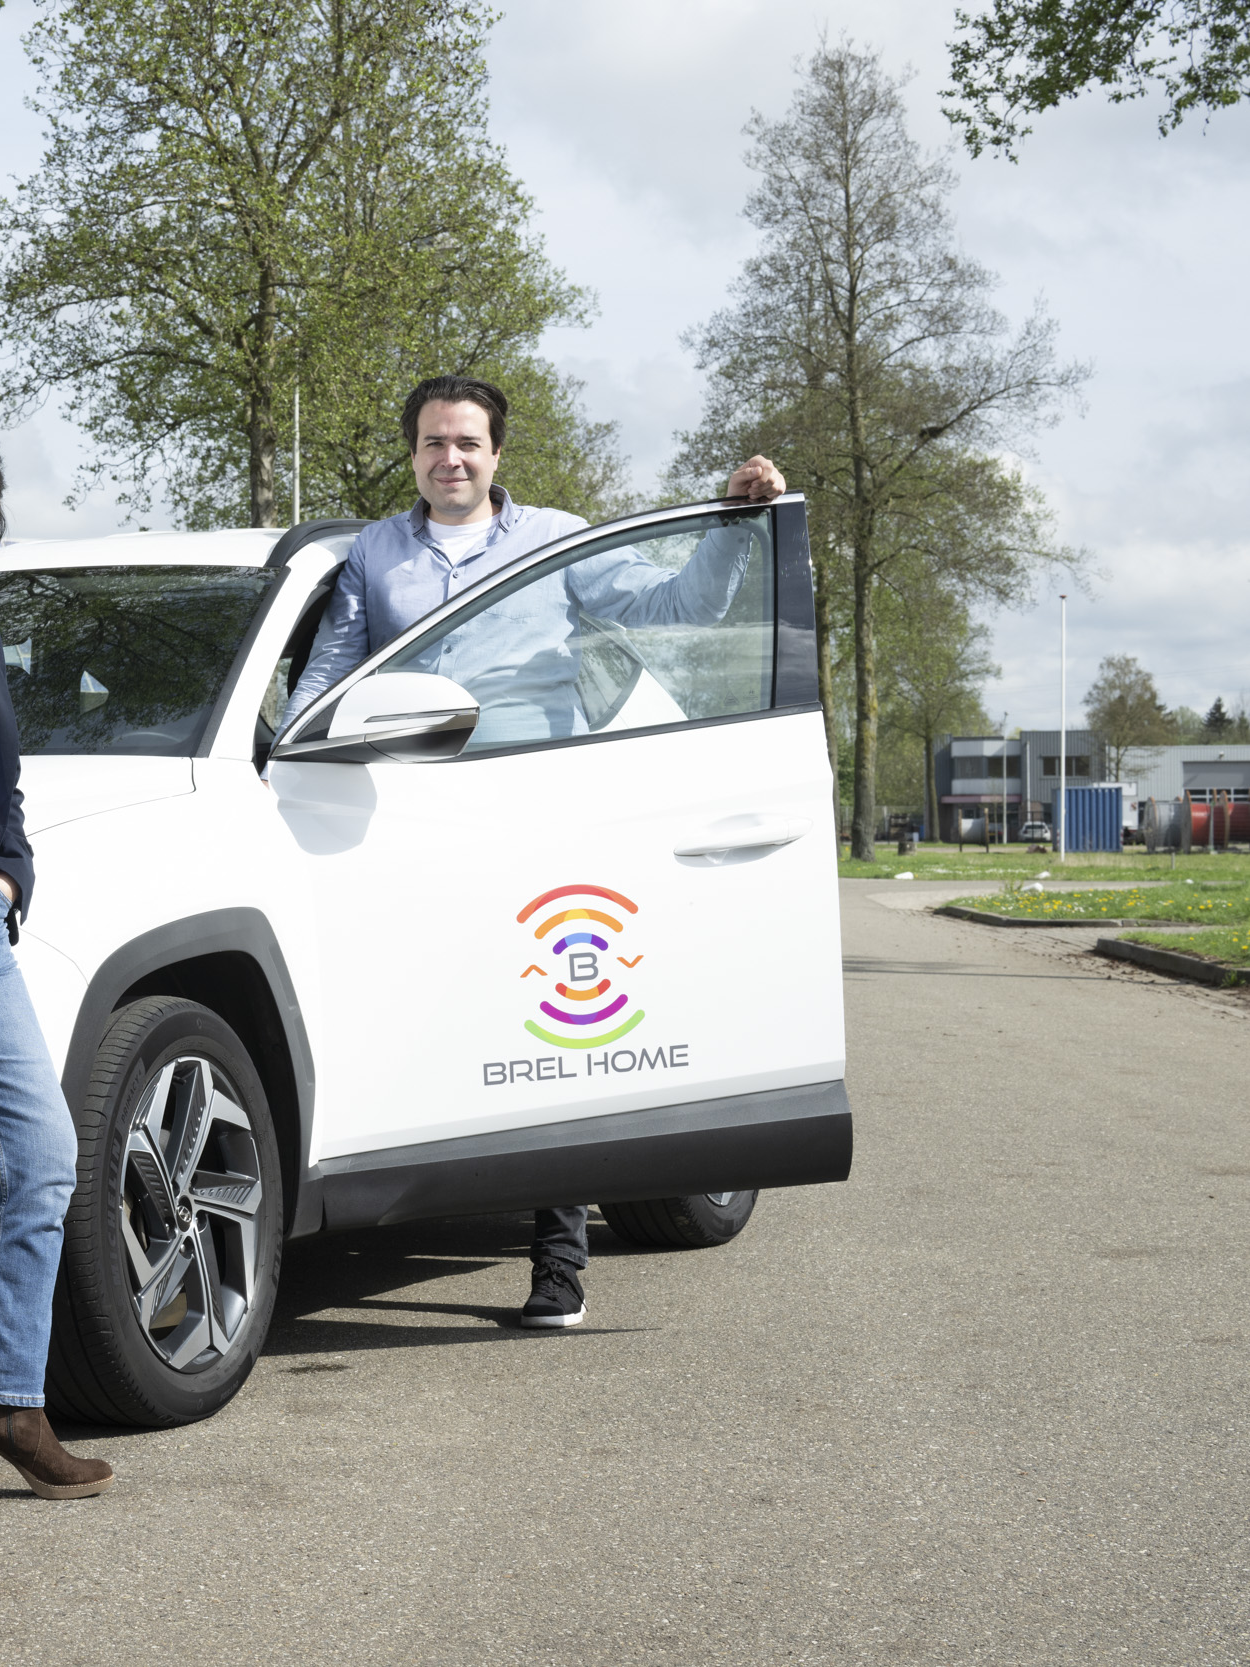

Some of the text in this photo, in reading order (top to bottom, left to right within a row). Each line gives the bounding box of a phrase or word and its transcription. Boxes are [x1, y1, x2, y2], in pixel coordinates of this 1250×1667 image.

[568, 952, 599, 982] B
[483, 1044, 689, 1086] BREL HOME
[106, 1135, 122, 1286] MICHELIN
